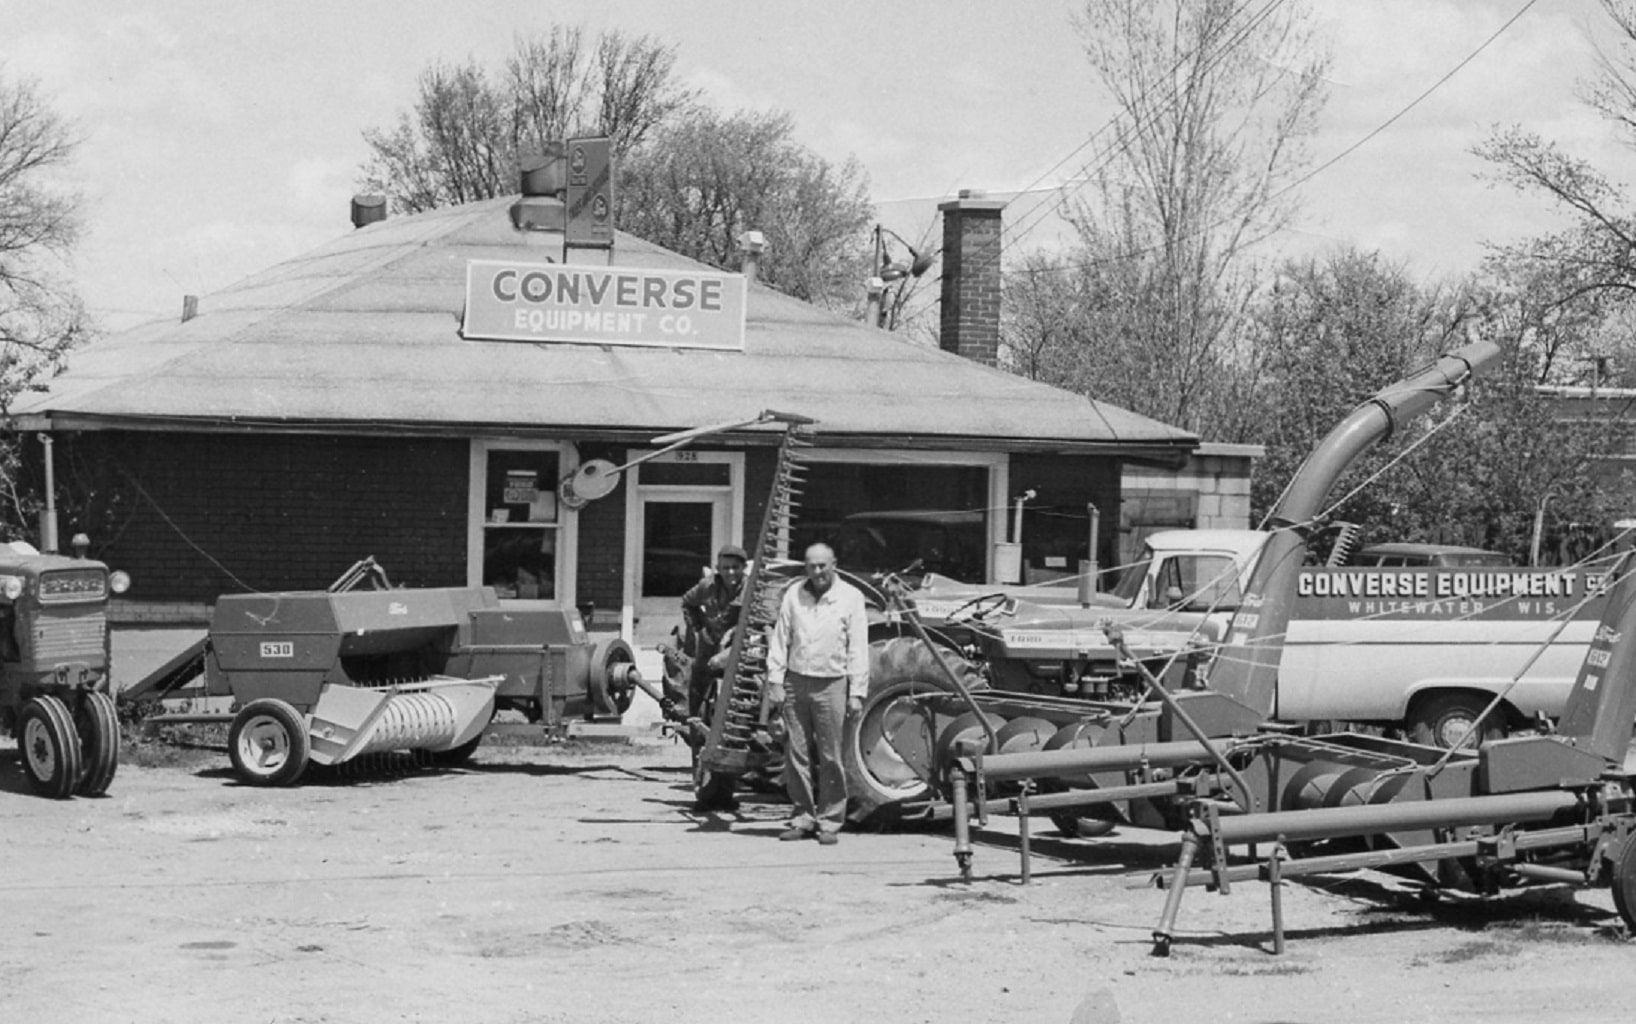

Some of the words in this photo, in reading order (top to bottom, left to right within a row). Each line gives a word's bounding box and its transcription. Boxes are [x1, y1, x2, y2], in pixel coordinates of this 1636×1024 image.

[492, 270, 722, 311] CONVERSE
[514, 309, 647, 333] EQUIPMENT
[659, 315, 699, 335] CO.
[1299, 572, 1429, 595] CONVERSE
[1437, 572, 1577, 596] EQUIPMENT
[1348, 600, 1484, 614] WHITEWATER
[1518, 601, 1561, 615] WIS.
[263, 644, 290, 655] 530
